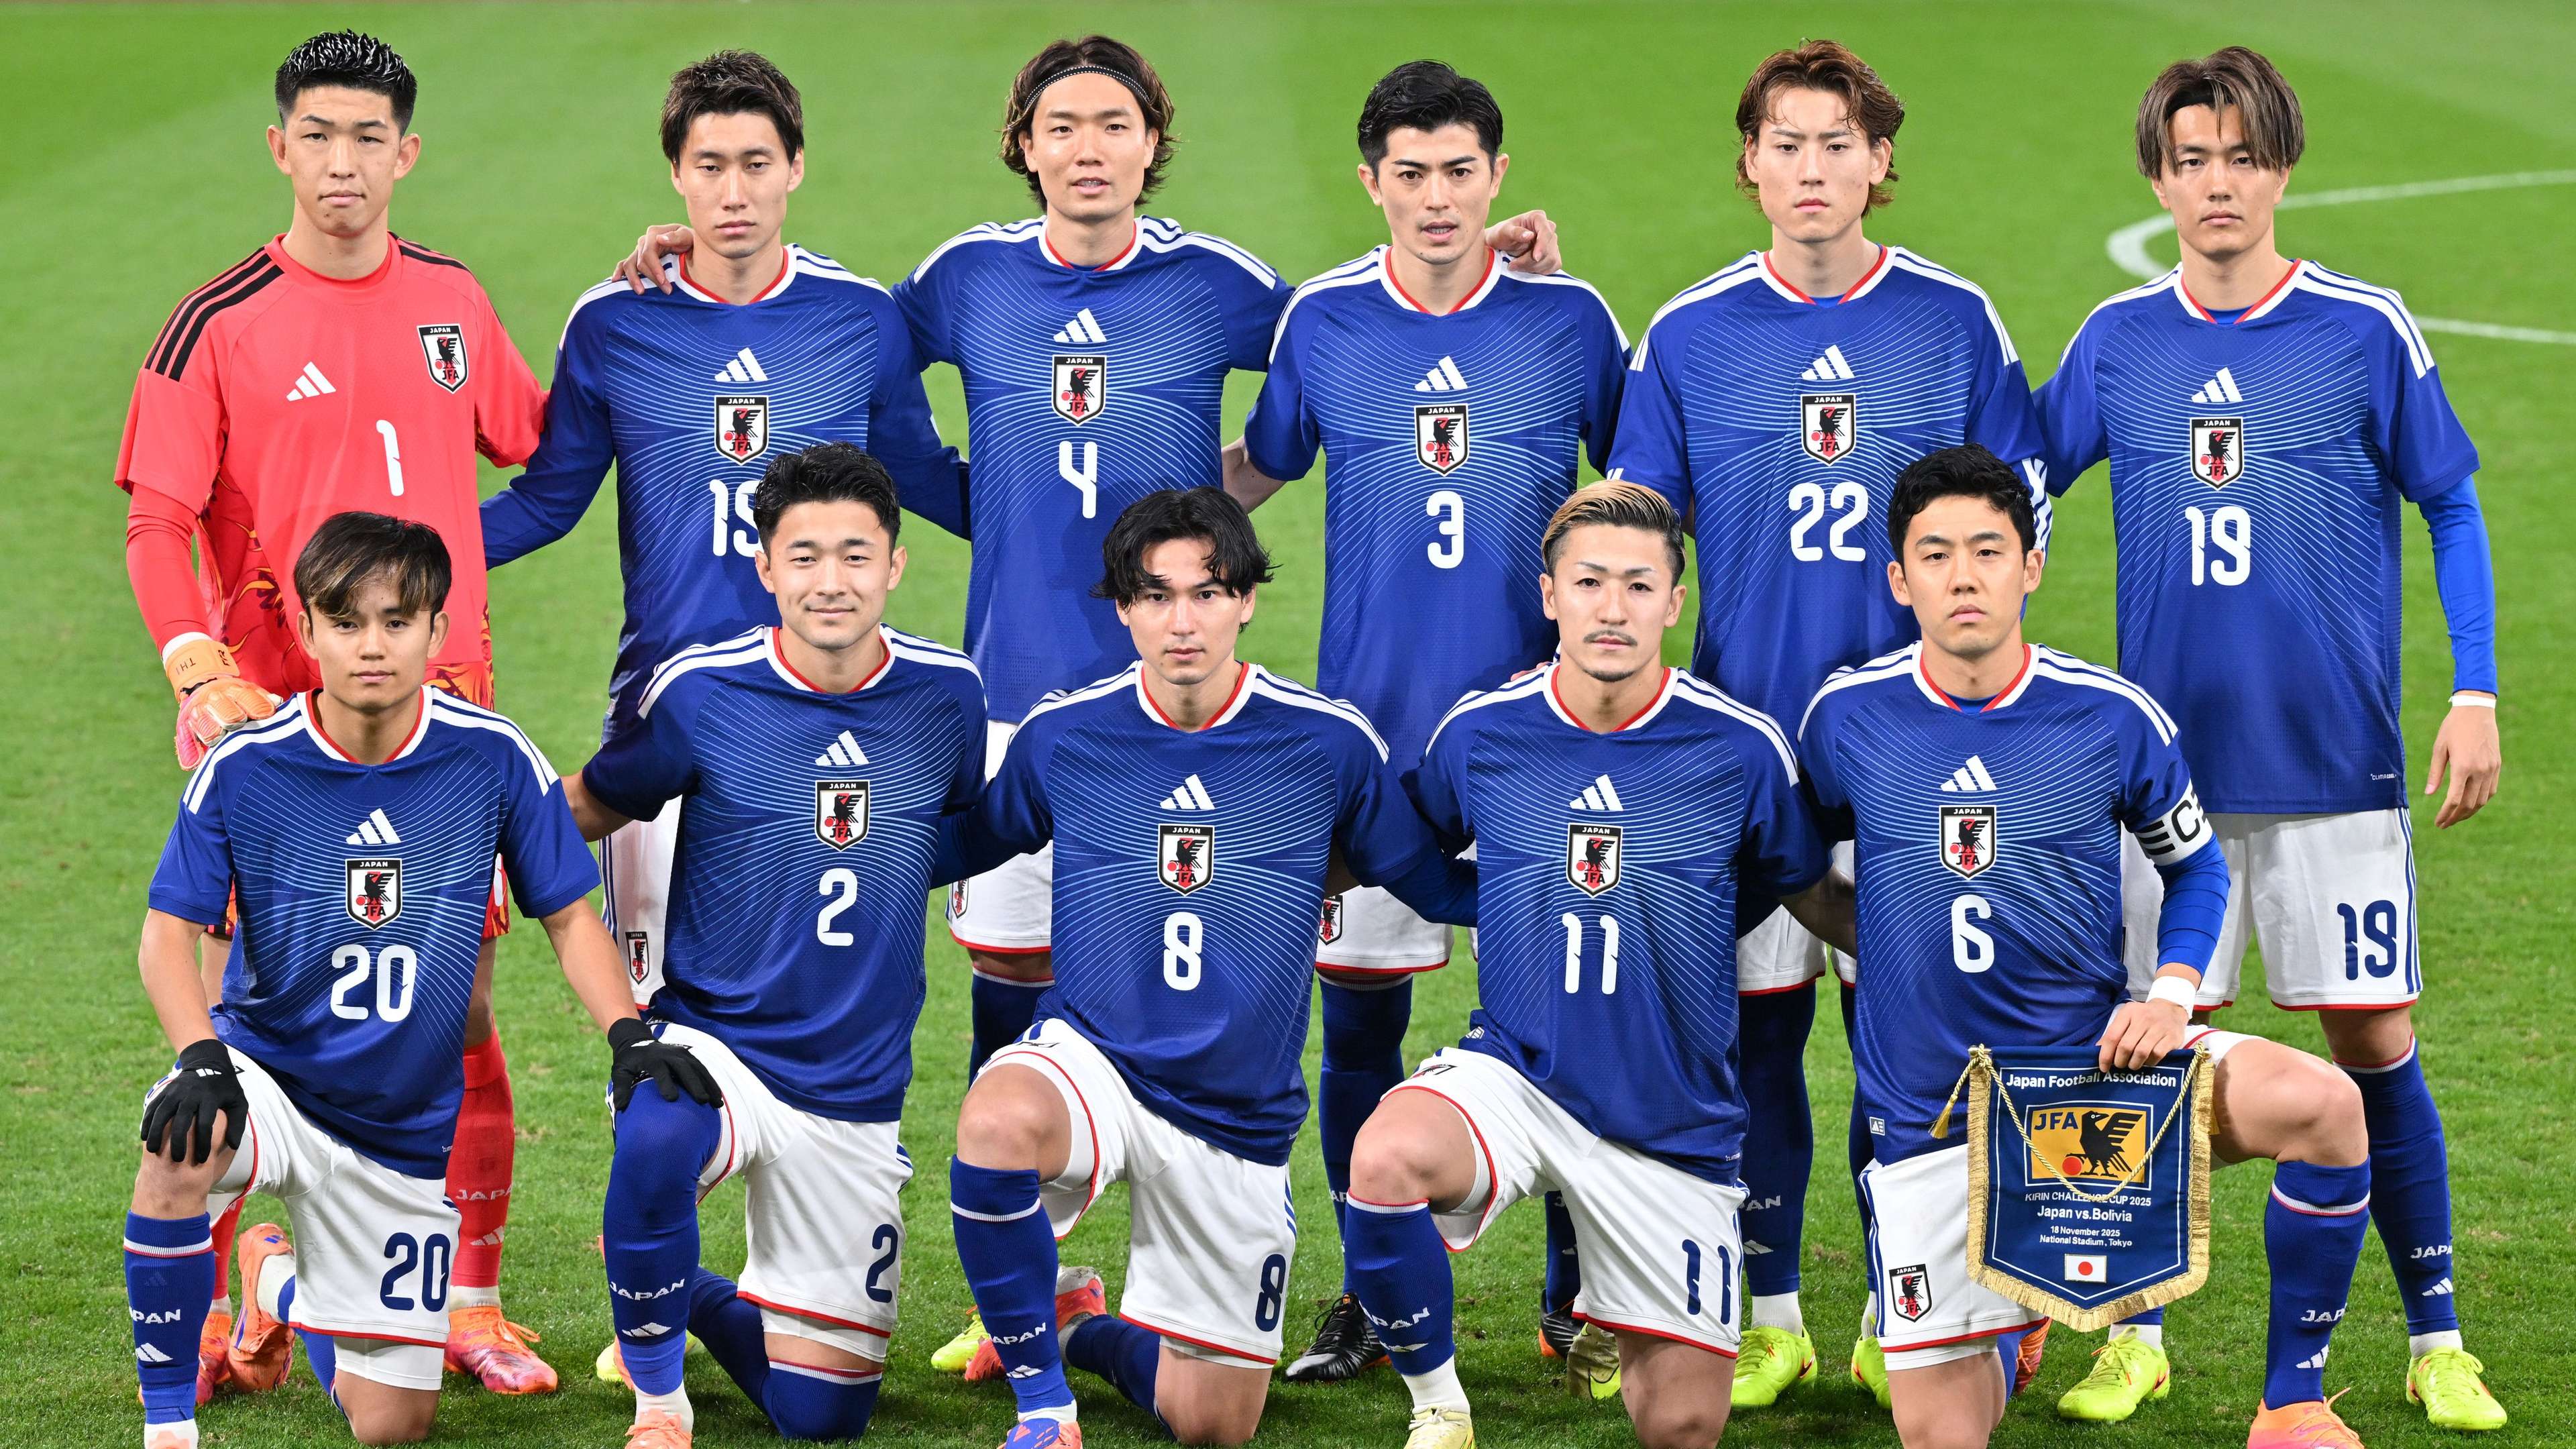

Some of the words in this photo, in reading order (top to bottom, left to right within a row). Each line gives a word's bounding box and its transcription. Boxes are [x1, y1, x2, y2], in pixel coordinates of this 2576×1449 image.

[442, 370, 460, 380] JFA
[1067, 402, 1089, 412] JFA
[1428, 407, 1455, 415] JAPAN
[729, 441, 753, 452] JFA
[1817, 441, 1840, 452] JFA
[376, 420, 404, 496] 1
[1432, 451, 1455, 463] JFA
[1059, 441, 1097, 519] 4
[2206, 466, 2229, 476] JFA
[709, 479, 765, 557] 15
[1788, 481, 1869, 561] 22
[1426, 490, 1464, 569] 3
[2185, 506, 2251, 586] 19
[829, 827, 853, 839] JFA
[1582, 826, 1610, 835] JAPAN
[1955, 855, 1980, 865] JFA
[1173, 872, 1197, 883] JFA
[1581, 872, 1605, 884] JFA
[362, 906, 386, 917] JFA
[817, 868, 858, 947] 2
[1951, 894, 1994, 973] 6
[2337, 900, 2397, 981] 19
[1163, 912, 1203, 991] 8
[1562, 912, 1619, 994] 11
[330, 944, 417, 1022] 20
[2006, 1074, 2045, 1089] Japan
[2049, 1073, 2100, 1087] Football
[2103, 1071, 2176, 1087] Association
[2034, 1112, 2079, 1130] JFA
[2025, 1193, 2049, 1201] KIRIN
[2109, 1196, 2128, 1205] CUP
[2130, 1197, 2151, 1206] 2025
[2037, 1205, 2073, 1220] Japan
[2060, 1227, 2099, 1236] November
[2102, 1229, 2121, 1237] 2025
[2039, 1235, 2071, 1244] National
[2110, 1239, 2133, 1248] Tokyo
[380, 1232, 450, 1311] 20
[866, 1224, 899, 1303] 2
[1896, 1266, 1917, 1275] JAPAN
[610, 1277, 686, 1301] JAPAN
[1682, 1240, 1731, 1325] 11
[1255, 1253, 1287, 1332] 8
[129, 1305, 181, 1324] PAN
[1904, 1303, 1922, 1314] JFA
